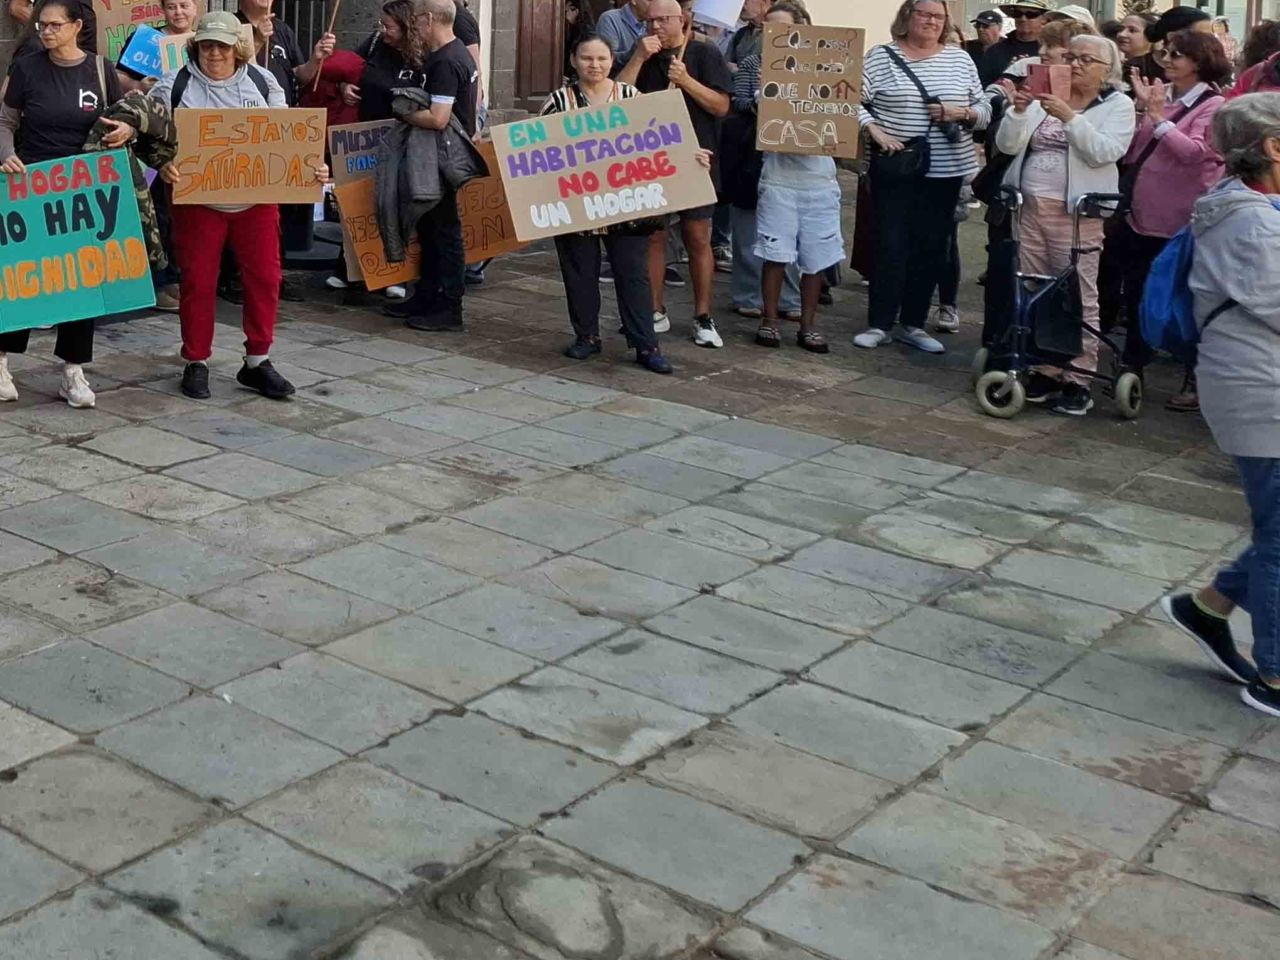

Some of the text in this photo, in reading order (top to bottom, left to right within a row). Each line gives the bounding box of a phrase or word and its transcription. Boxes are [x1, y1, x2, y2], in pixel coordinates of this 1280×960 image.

[808, 83, 832, 100] NO
[199, 114, 320, 147] ESTAMOS
[507, 103, 630, 149] EN UNA
[507, 117, 683, 178] HABITACIÓN
[759, 119, 838, 148] CASA
[5, 155, 121, 202] HOGAR
[176, 147, 320, 197] SATURADAS
[557, 150, 677, 199] NO CABE
[43, 185, 120, 241] HAY
[530, 201, 572, 228] UN
[584, 183, 667, 221] HOGAR
